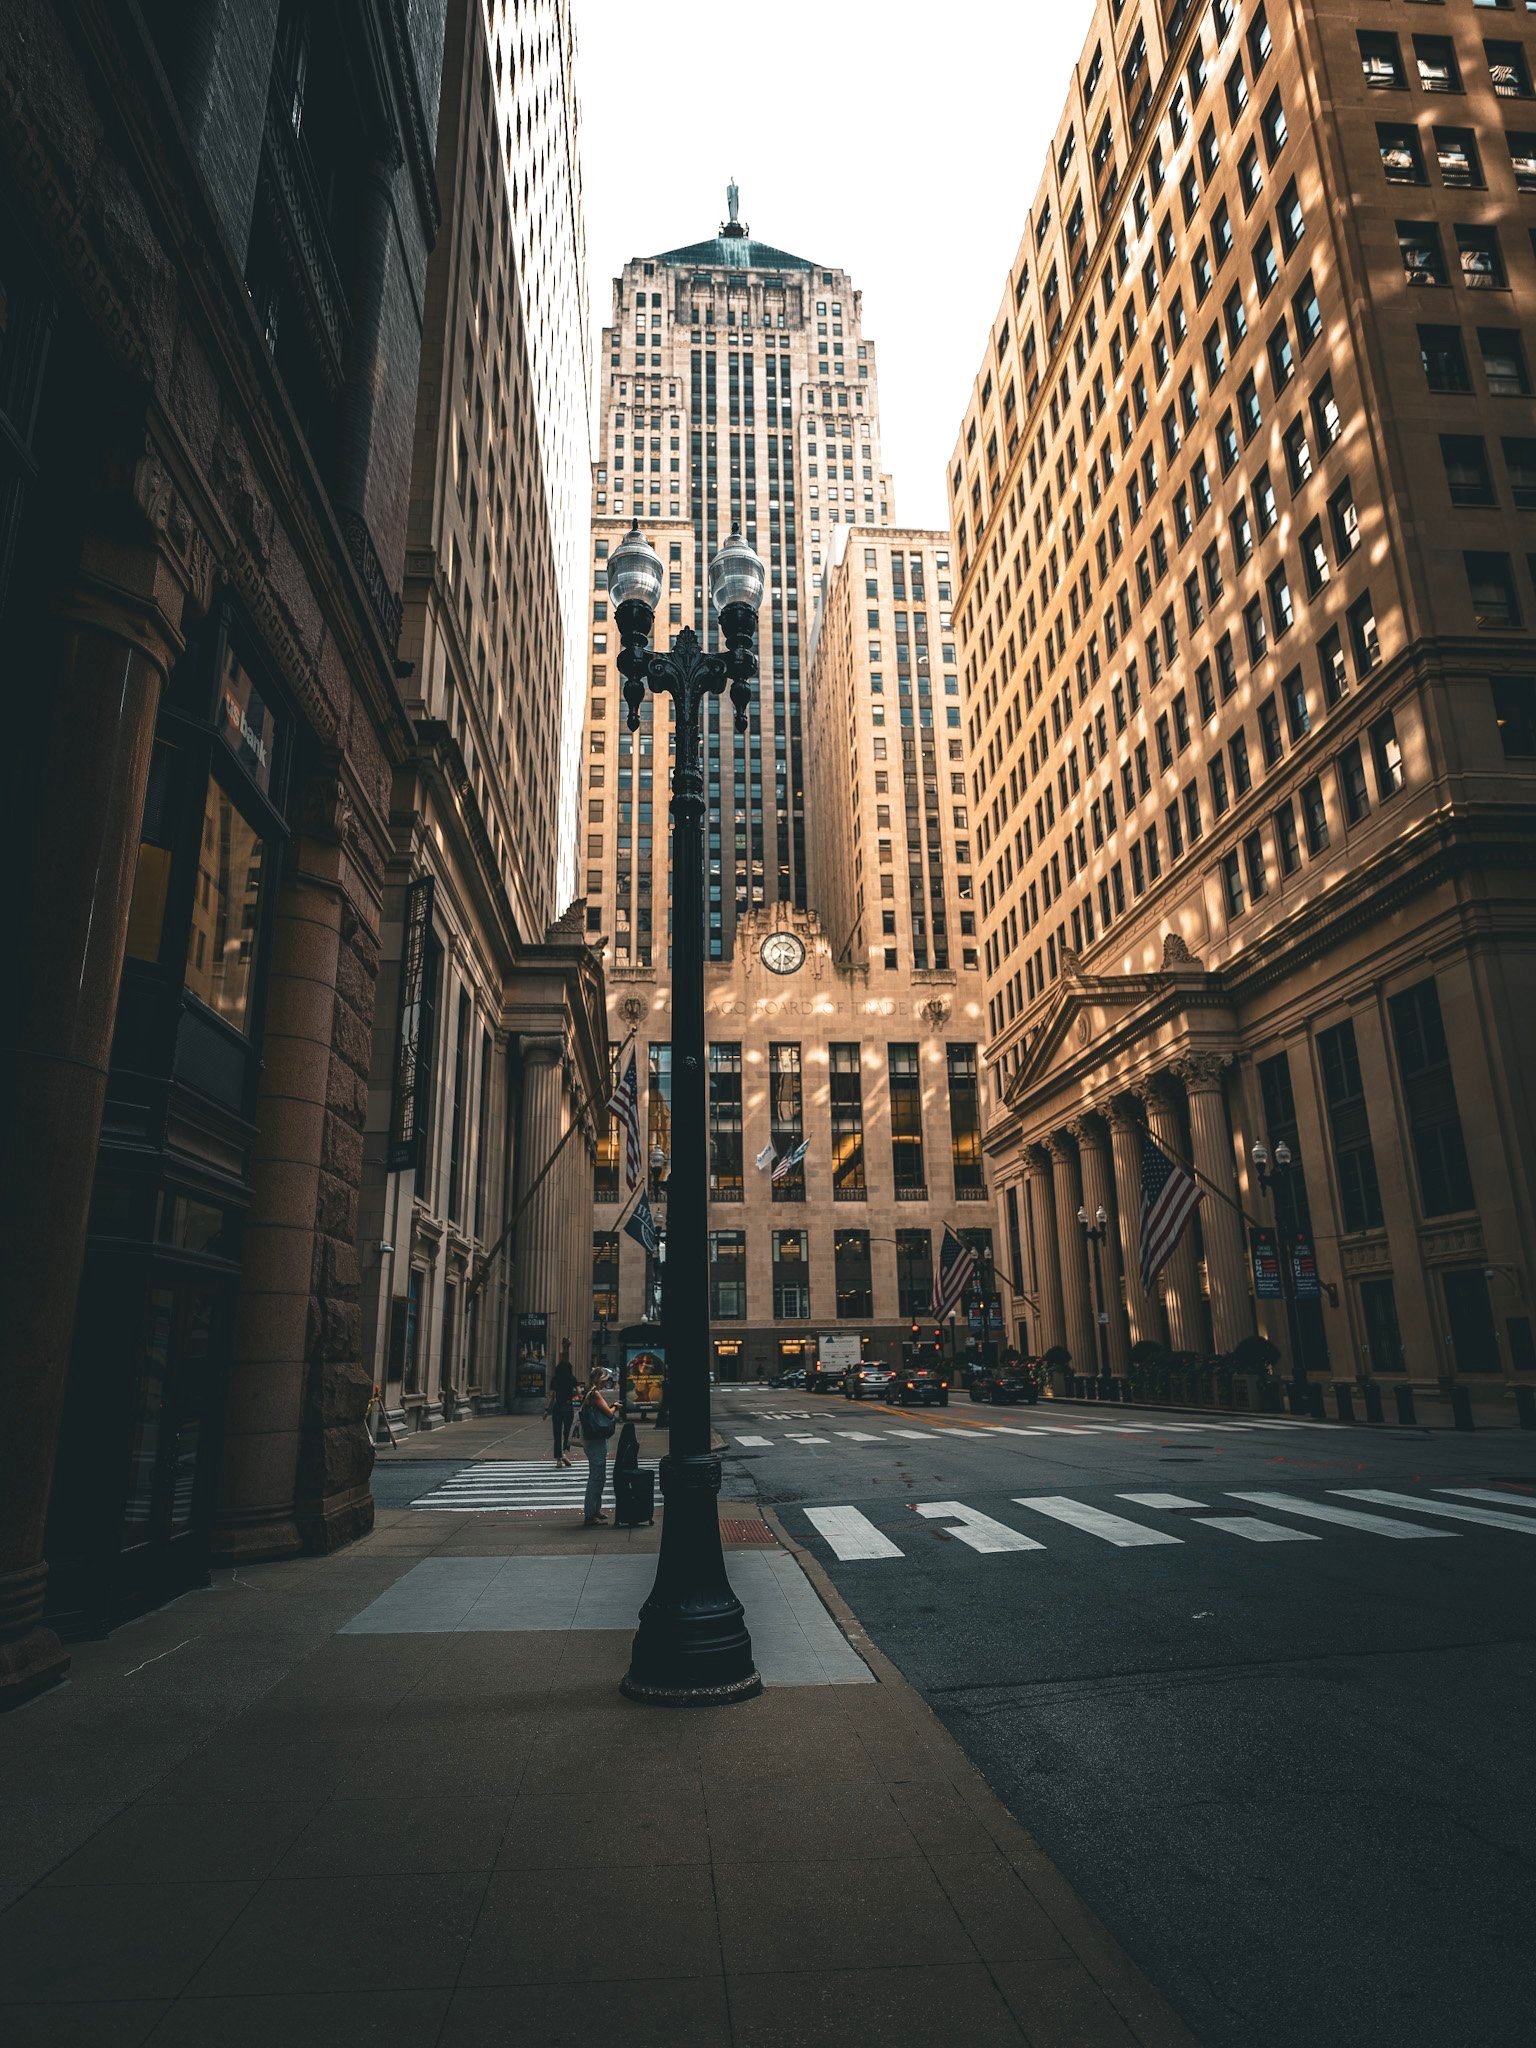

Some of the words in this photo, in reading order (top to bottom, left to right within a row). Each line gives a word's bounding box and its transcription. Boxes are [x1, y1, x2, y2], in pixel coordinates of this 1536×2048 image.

[755, 1001, 814, 1015] BOARD
[821, 1001, 843, 1015] OF
[853, 1001, 908, 1015] TRADE
